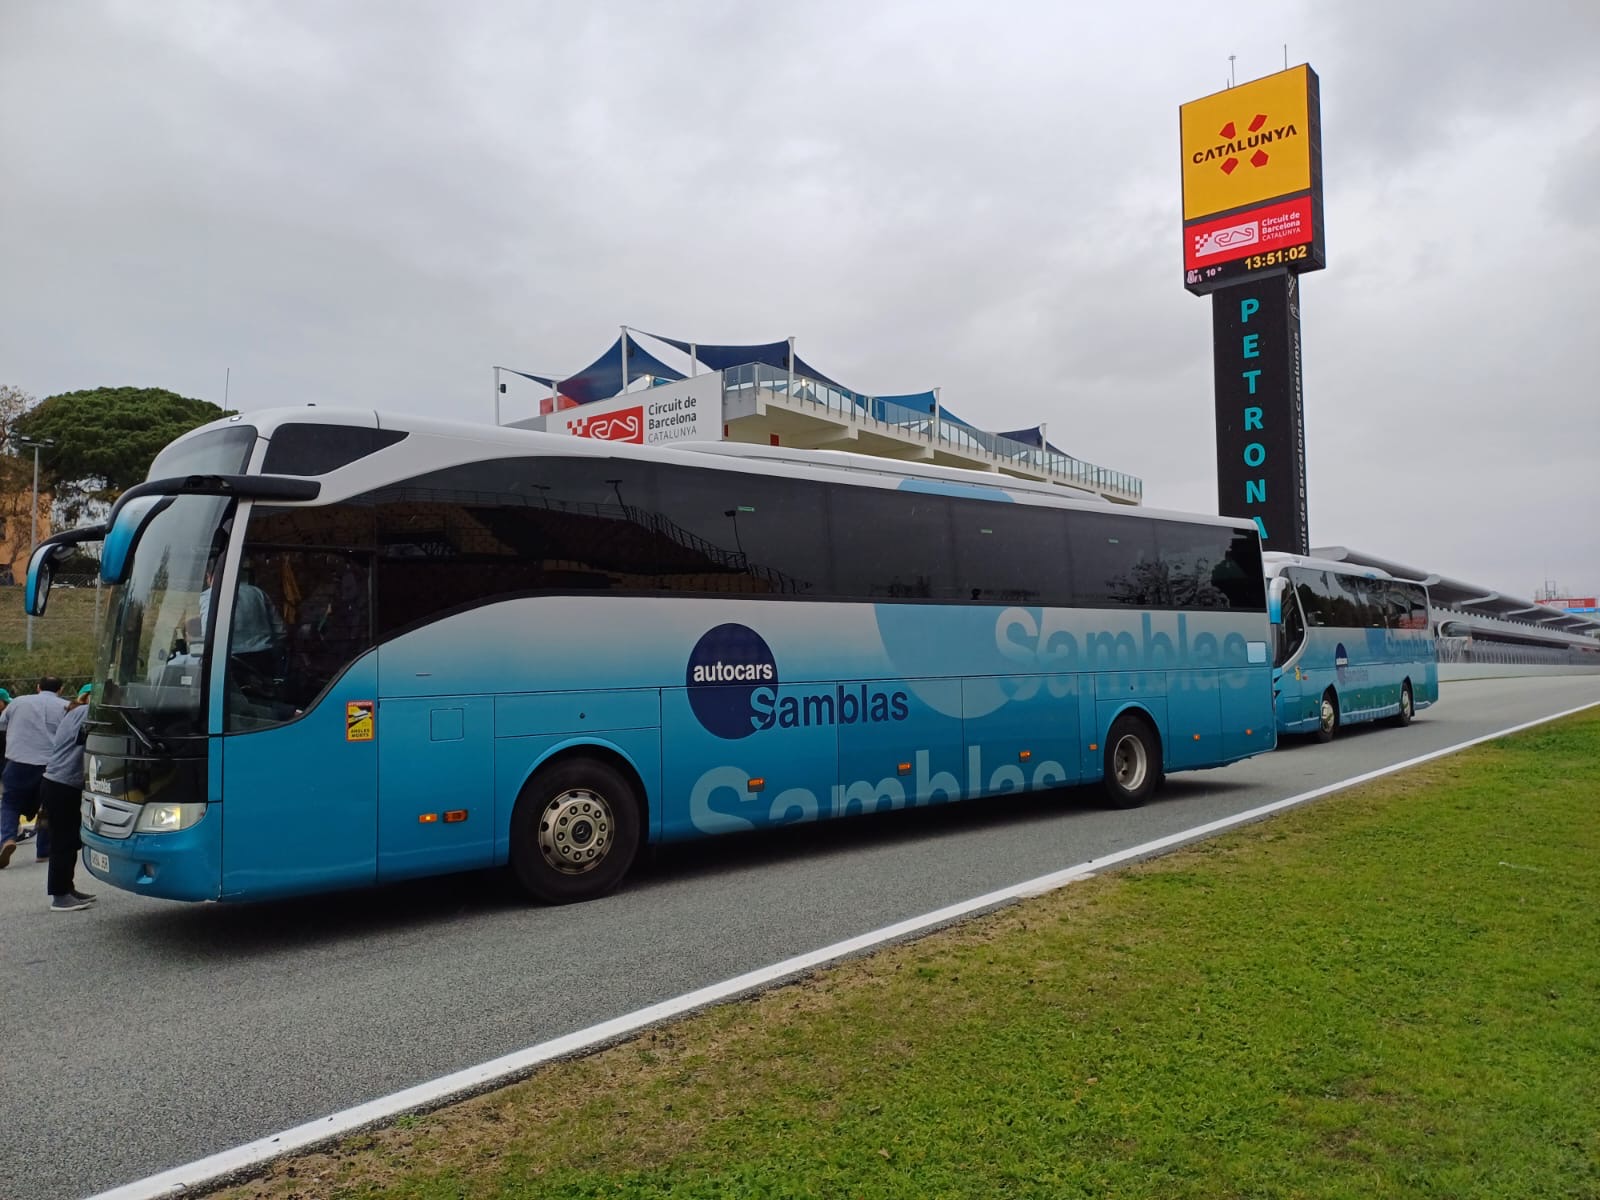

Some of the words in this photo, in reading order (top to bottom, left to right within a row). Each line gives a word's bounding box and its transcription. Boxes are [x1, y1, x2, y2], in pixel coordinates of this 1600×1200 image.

[1192, 124, 1297, 164] CATALUNYA
[1261, 214, 1288, 227] Circuit
[1261, 220, 1301, 234] Barcelona
[1262, 228, 1301, 241] CATALUNYA
[1244, 245, 1307, 270] 13:51:02
[648, 399, 682, 416] Circuit
[683, 396, 697, 408] de
[648, 411, 697, 430] Barcelona
[648, 426, 697, 443] CATALUNYA
[995, 607, 1250, 701] Samblas
[693, 660, 773, 682] autocars
[750, 684, 909, 731] Samblas
